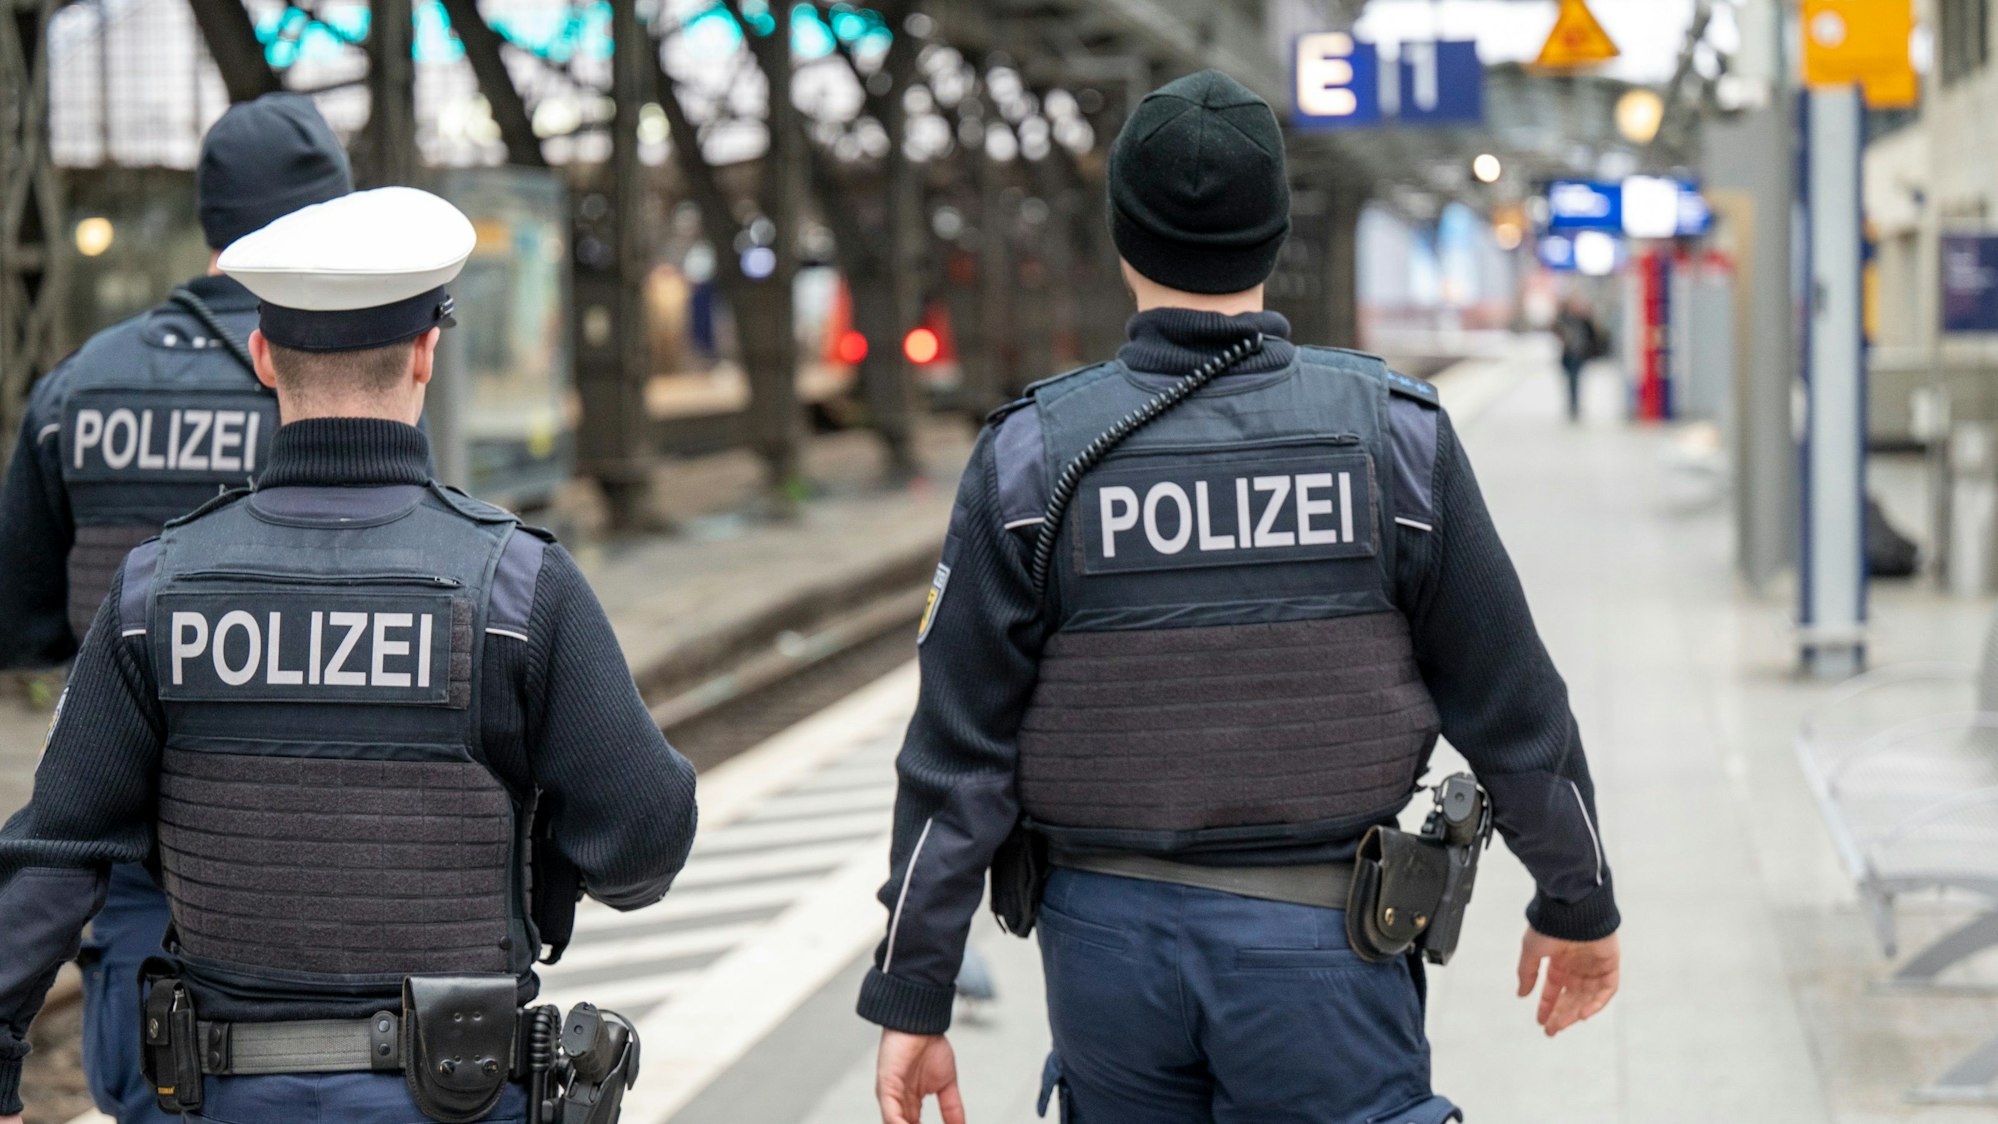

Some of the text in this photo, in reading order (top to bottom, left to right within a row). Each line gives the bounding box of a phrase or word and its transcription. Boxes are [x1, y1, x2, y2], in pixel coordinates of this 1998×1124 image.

[1297, 31, 1357, 116] E
[75, 409, 261, 471] POLIZEI
[1099, 471, 1354, 558] POLIZEI
[171, 609, 433, 688] POLIZEI
